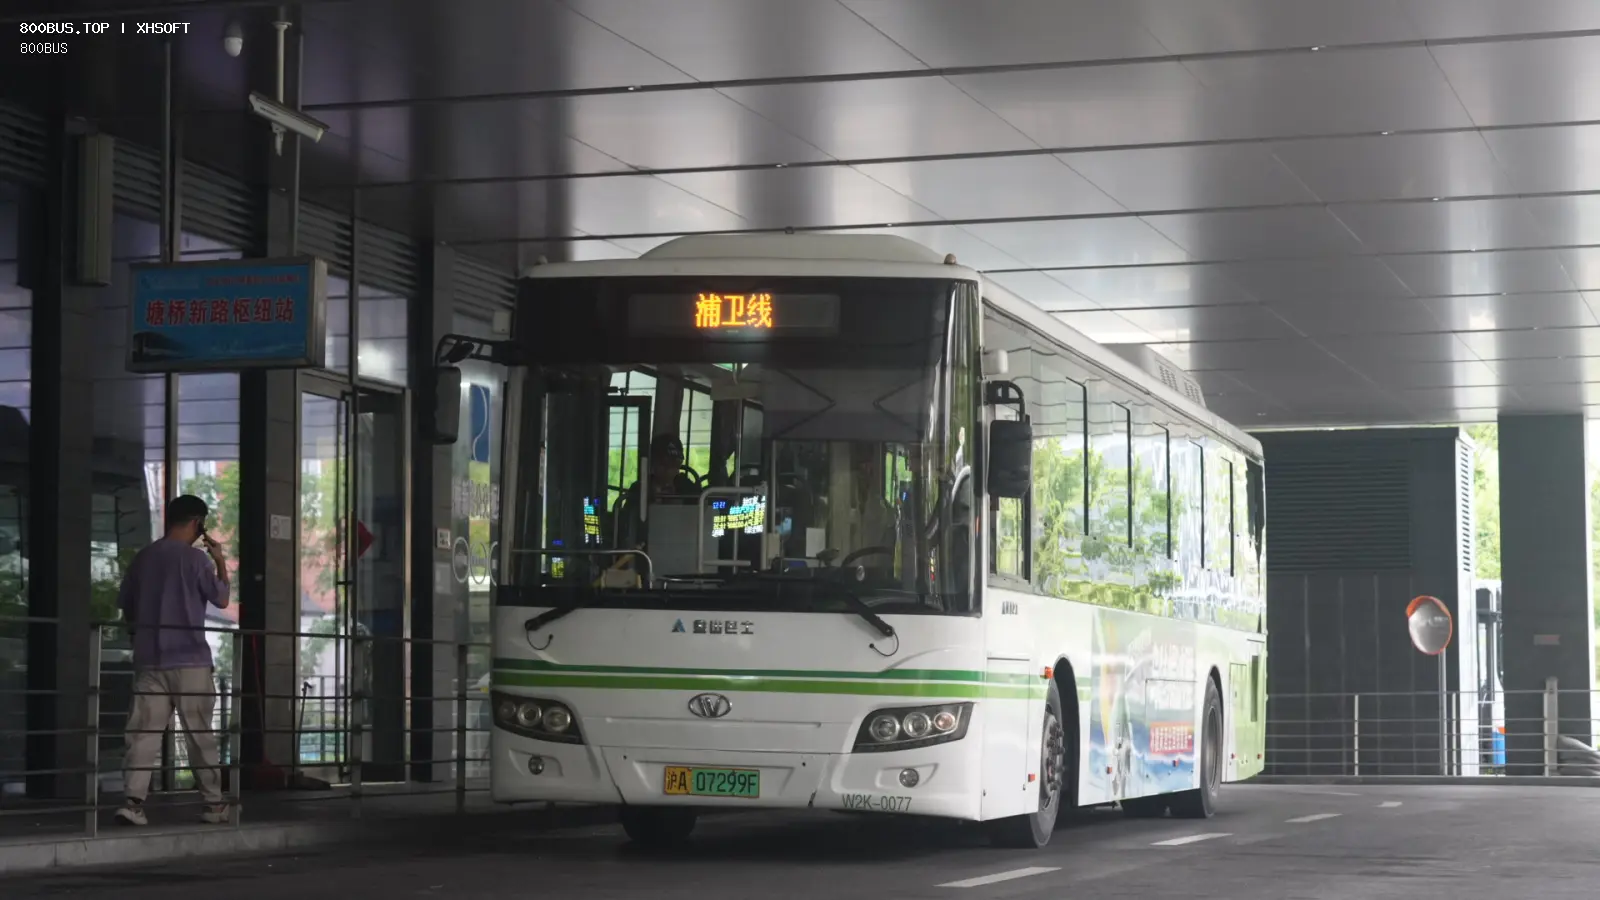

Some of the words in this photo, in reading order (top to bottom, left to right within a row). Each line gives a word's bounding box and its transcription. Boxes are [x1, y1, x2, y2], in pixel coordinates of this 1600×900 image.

[145, 296, 295, 326] 塘桥新路枢纽站
[695, 293, 772, 328] 浦卫线
[666, 767, 688, 791] 沪A
[695, 770, 758, 794] 07299F
[842, 794, 912, 812] W2K-0077
